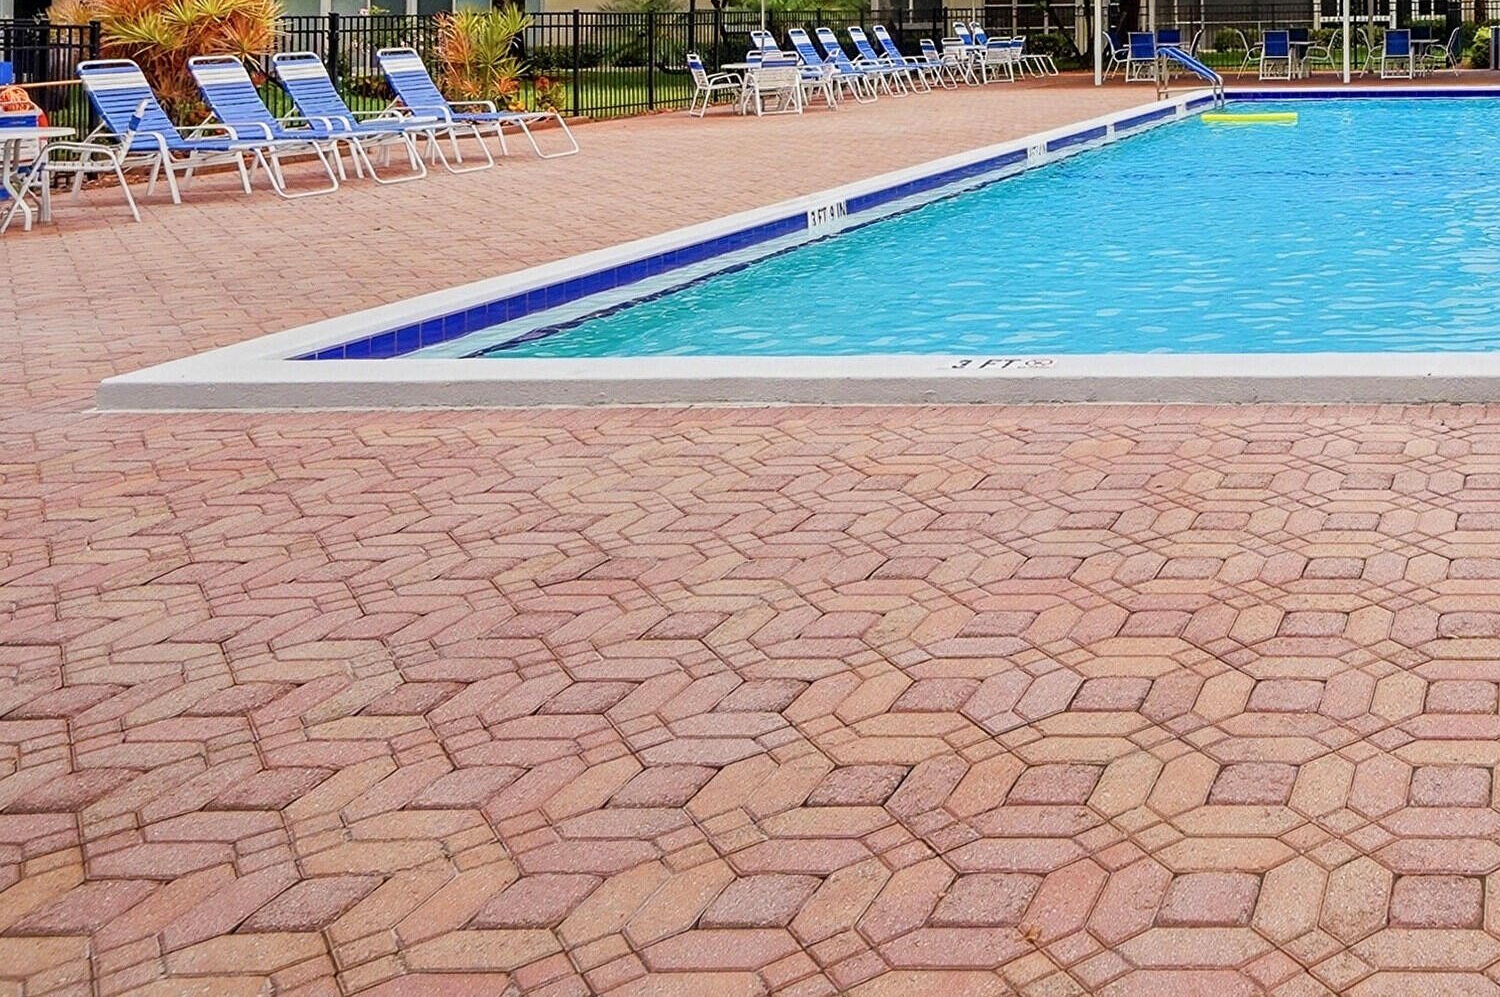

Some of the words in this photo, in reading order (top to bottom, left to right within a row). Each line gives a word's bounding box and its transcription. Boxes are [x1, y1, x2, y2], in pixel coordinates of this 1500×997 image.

[818, 206, 827, 224] FT
[836, 202, 846, 219] IN
[952, 359, 973, 369] 3
[979, 358, 1022, 369] FT
